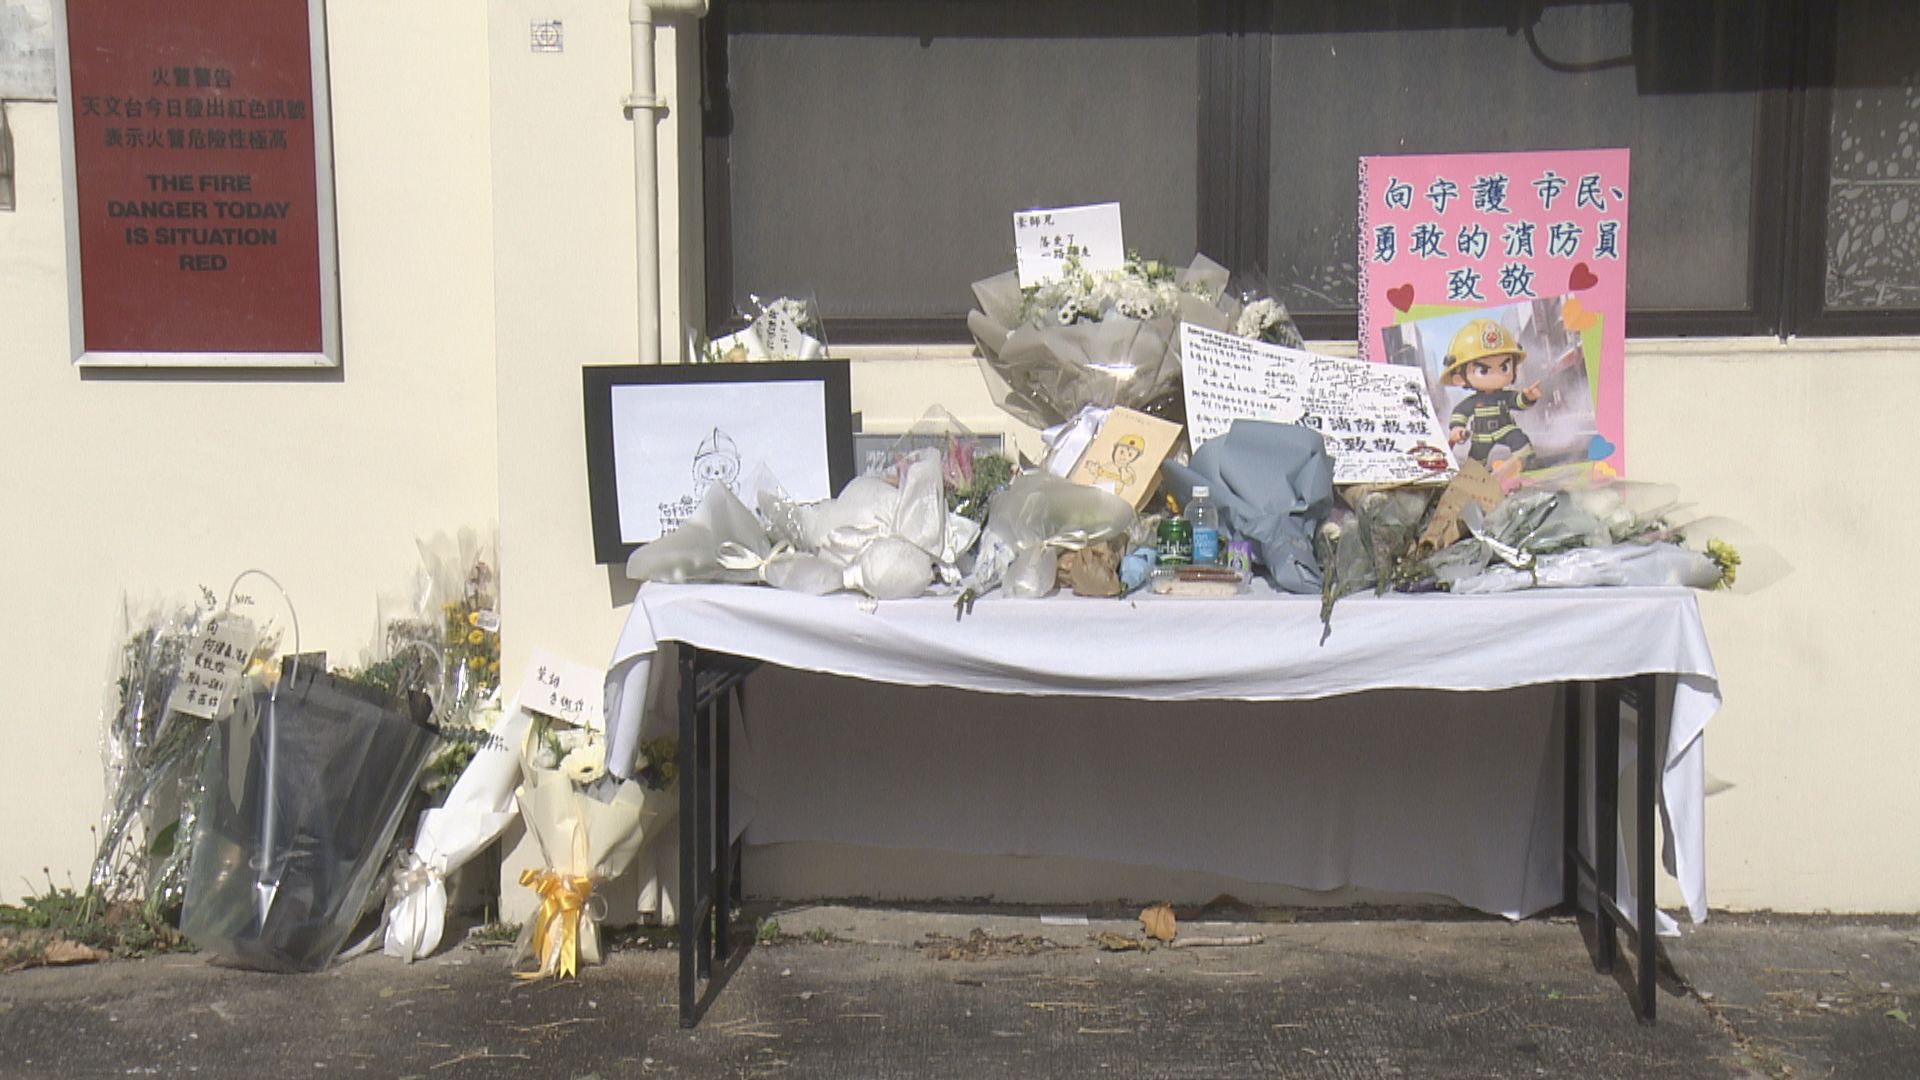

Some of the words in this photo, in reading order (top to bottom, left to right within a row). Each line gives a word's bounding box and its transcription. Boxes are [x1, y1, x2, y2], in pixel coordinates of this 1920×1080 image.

[152, 66, 232, 88] 火警警告
[81, 96, 306, 120] 天文台今日發出紅色訊號
[104, 127, 288, 150] 表示火警危險性極高
[146, 174, 193, 192] THE
[200, 175, 252, 193] FIRE
[107, 201, 208, 219] DANGER
[213, 201, 290, 219] TODAY
[125, 227, 149, 245] IS
[155, 227, 278, 246] SITUATION
[1373, 221, 1620, 262] 勇敢的消防員
[178, 253, 228, 271] RED
[1447, 263, 1536, 302] 致敬
